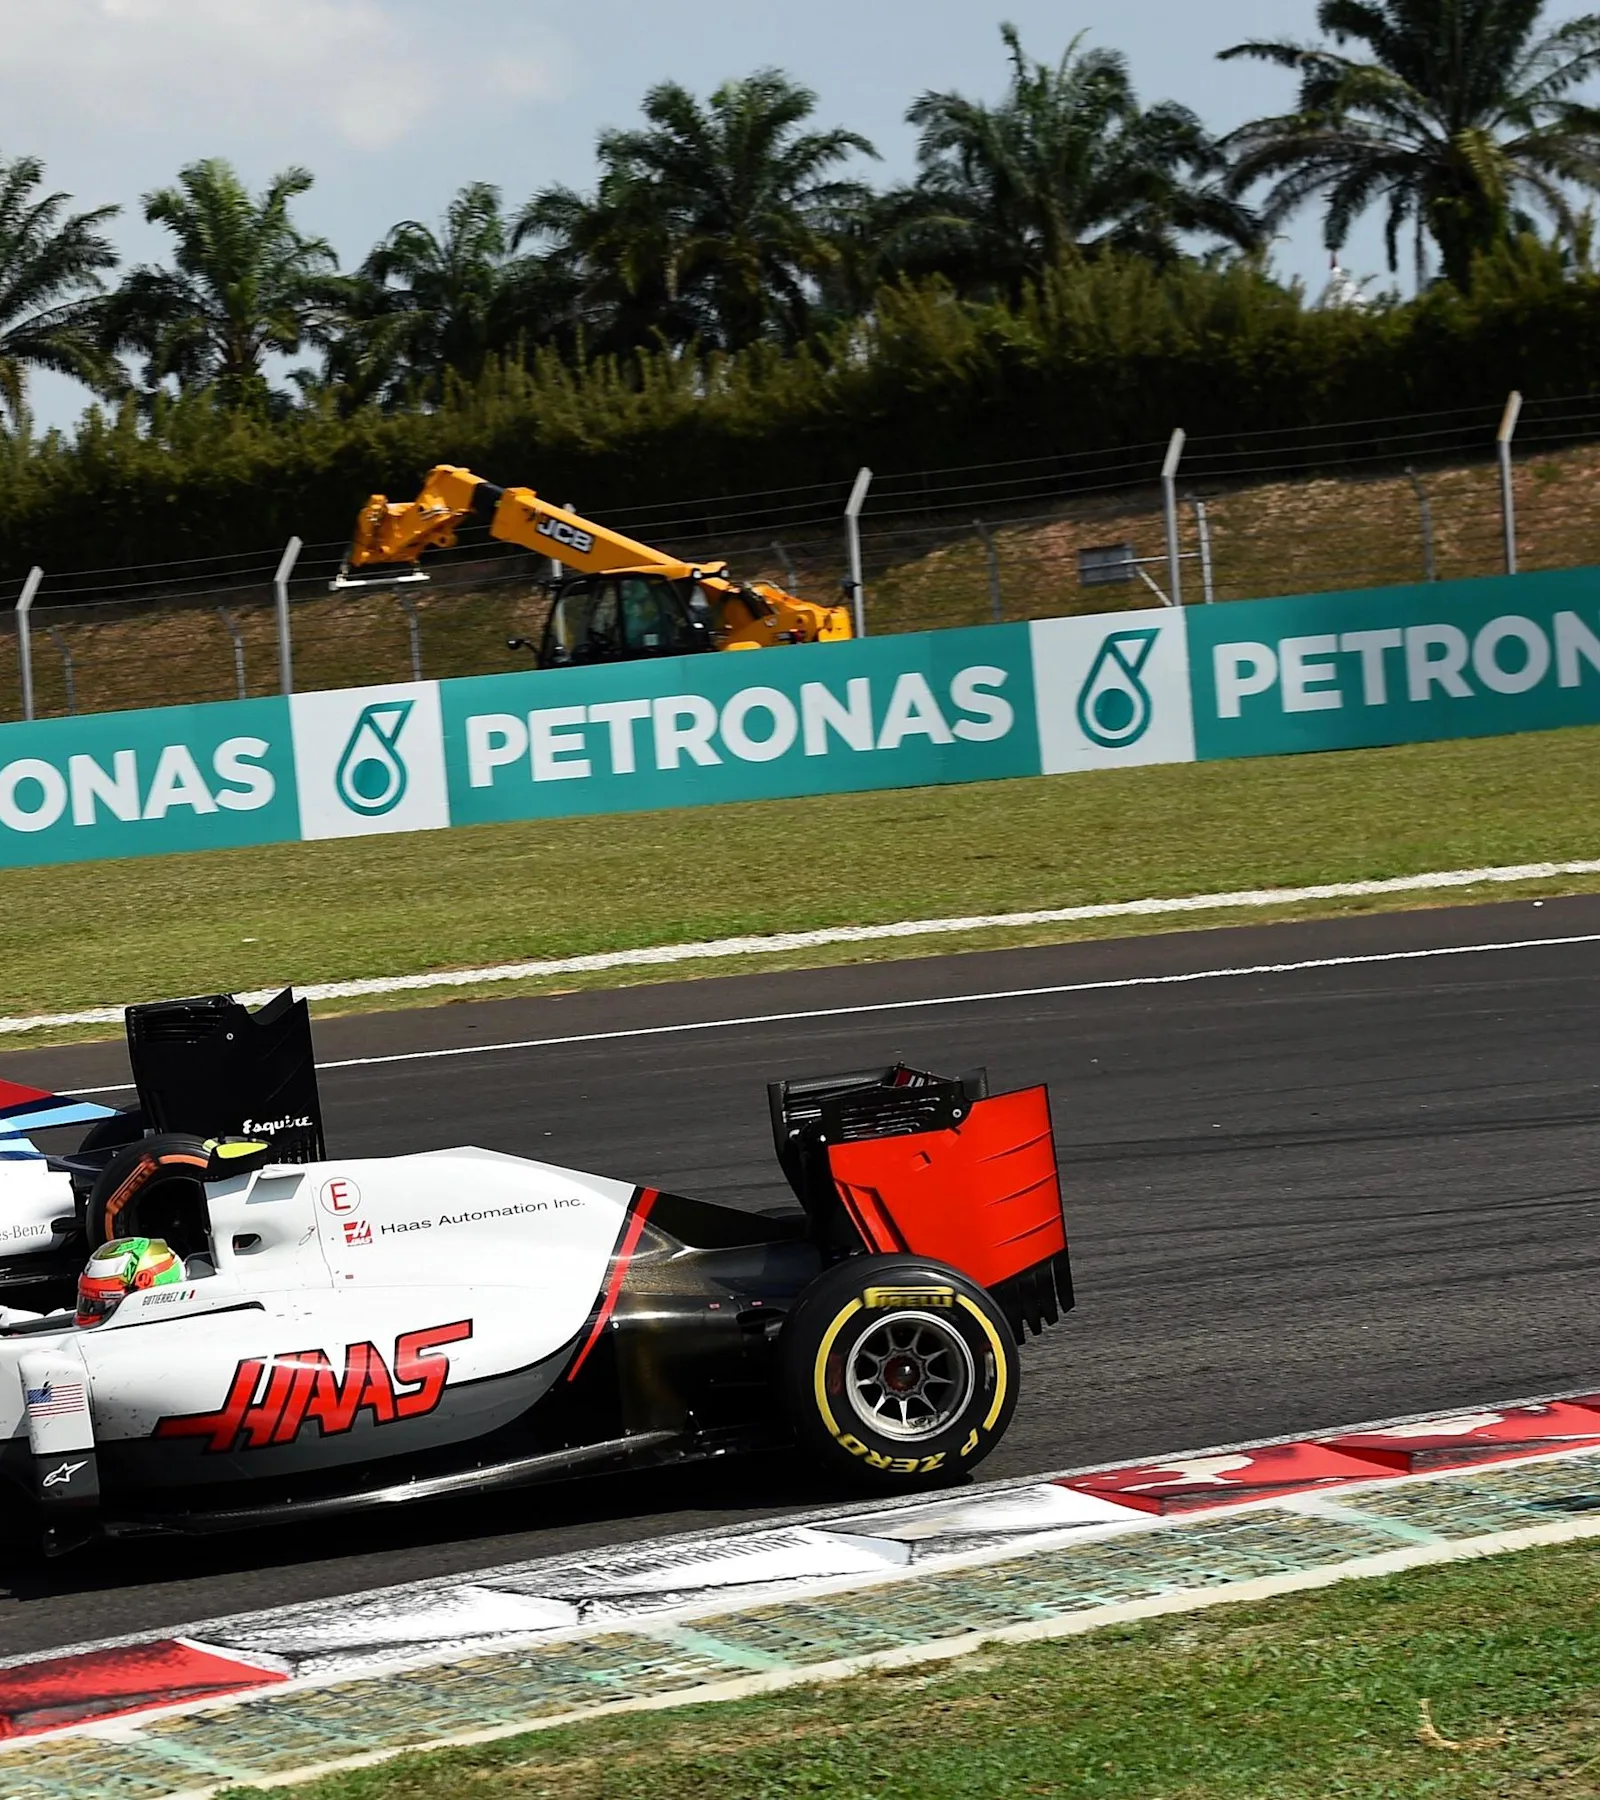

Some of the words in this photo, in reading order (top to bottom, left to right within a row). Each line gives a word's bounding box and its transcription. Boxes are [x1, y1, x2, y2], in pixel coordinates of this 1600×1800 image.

[536, 518, 594, 553] JCB
[467, 665, 1015, 788] PETRONAS
[243, 1115, 313, 1135] Esquire
[330, 1182, 352, 1211] E
[381, 1219, 432, 1235] Haas
[438, 1201, 548, 1226] Automation
[554, 1196, 586, 1210] Inc.
[151, 1319, 473, 1455] HAAS
[838, 1432, 947, 1473] ZERO
[961, 1428, 979, 1456] P
